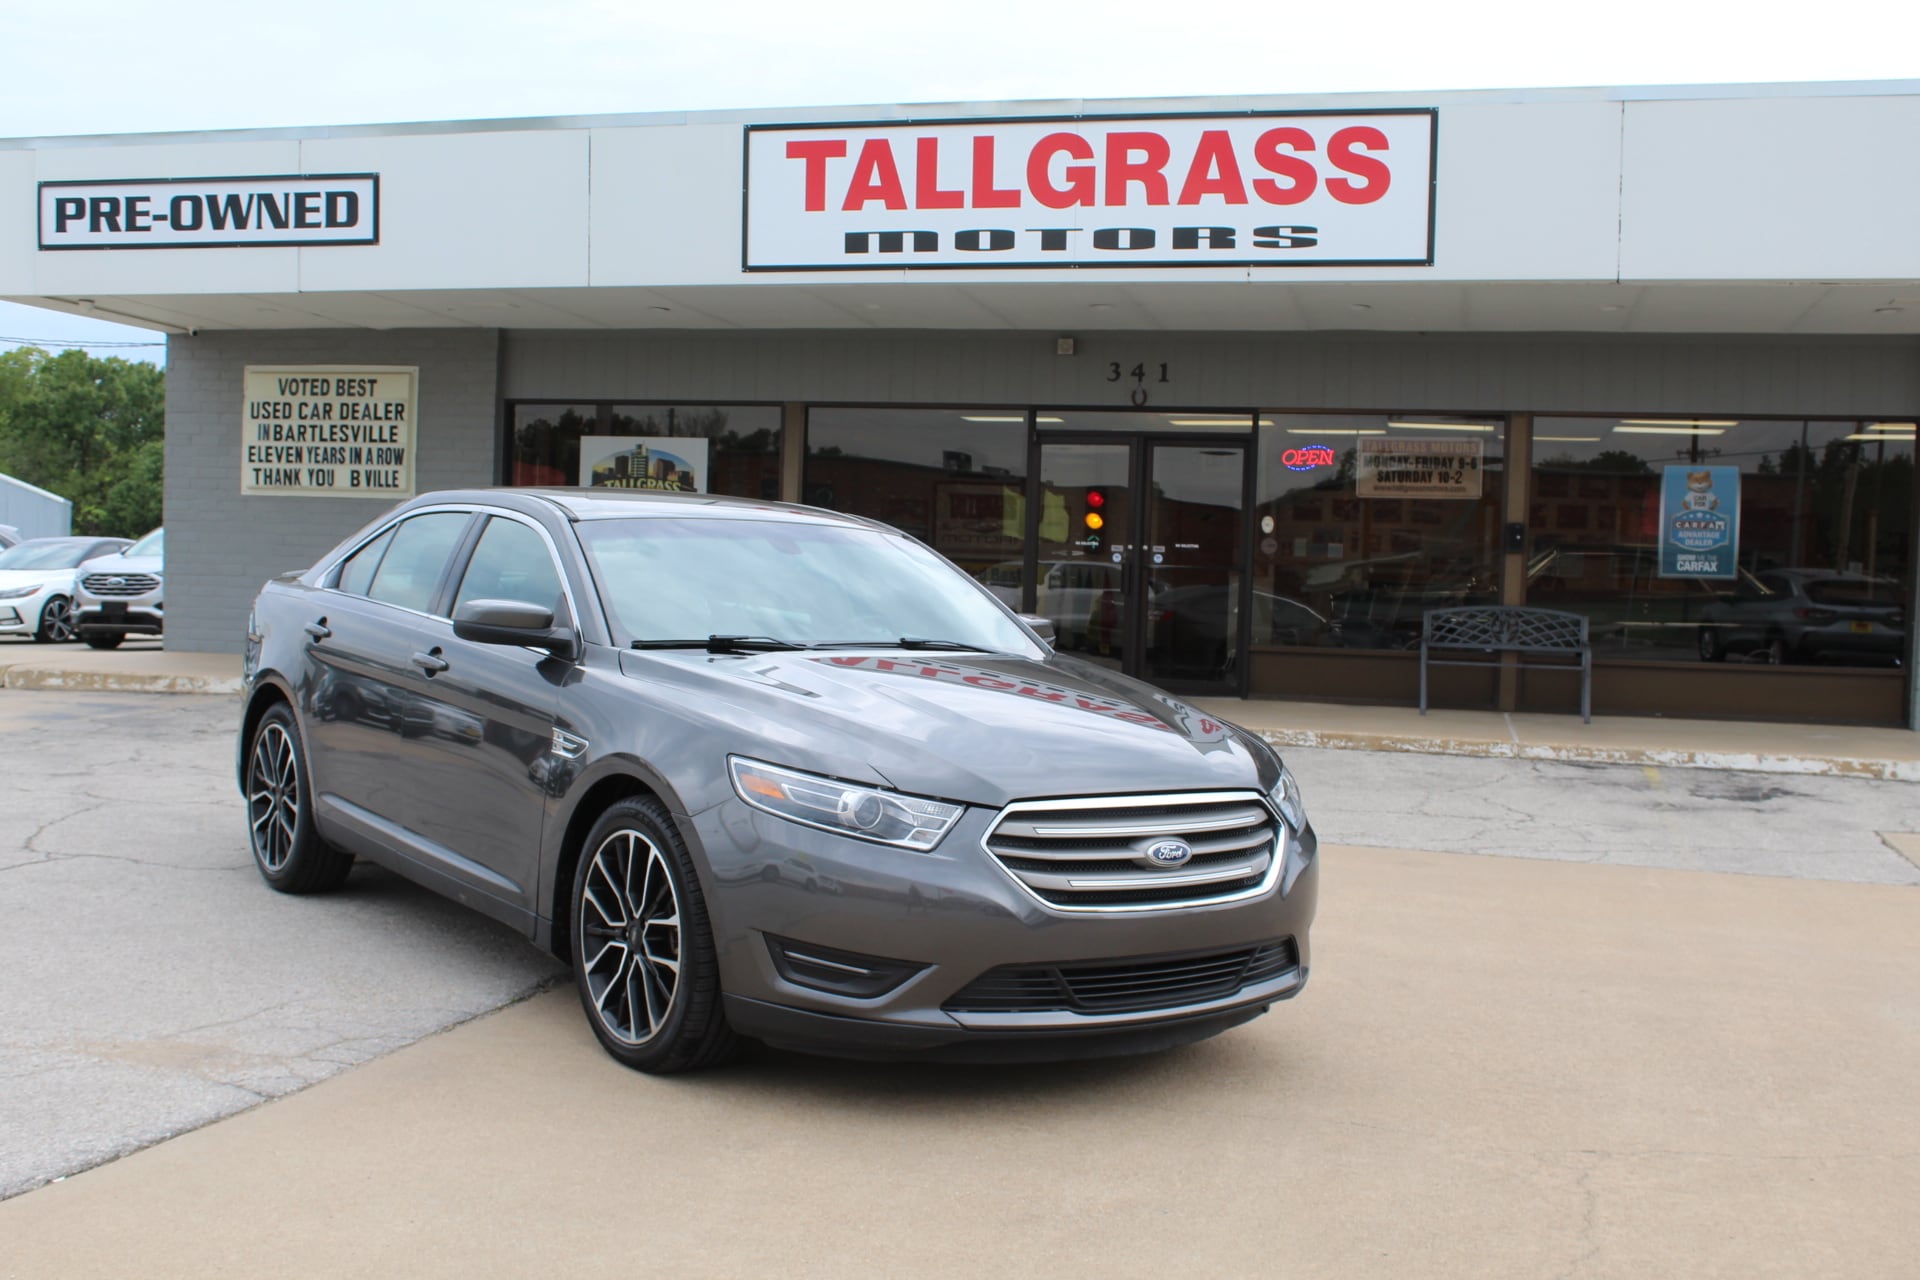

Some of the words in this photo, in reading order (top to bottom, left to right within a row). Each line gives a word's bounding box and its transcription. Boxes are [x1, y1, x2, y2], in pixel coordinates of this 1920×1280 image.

[785, 125, 1391, 212] TALLGRASS
[54, 191, 359, 233] PRE-OWNED
[844, 225, 1318, 254] MOTORS
[278, 378, 331, 397] VOTED
[335, 378, 377, 397] BEST
[250, 401, 292, 420] USED
[298, 402, 333, 421] CAR
[339, 402, 405, 421] DEALER
[257, 423, 270, 441] IN
[273, 424, 398, 443] BARTLESVILLE
[248, 445, 303, 463] ELEVEN
[306, 446, 346, 465] YEARS
[350, 447, 362, 465] IN
[365, 447, 374, 465] A
[376, 447, 405, 465] ROW
[1281, 449, 1335, 466] OPEN
[252, 468, 301, 486] THANK
[307, 468, 335, 487] YOU
[350, 469, 361, 487] B
[365, 469, 399, 488] VILLE
[1376, 470, 1434, 484] SATURDAY
[1437, 470, 1463, 484] 10-2
[1676, 561, 1718, 572] CARFAX
[1158, 845, 1184, 860] Ford
